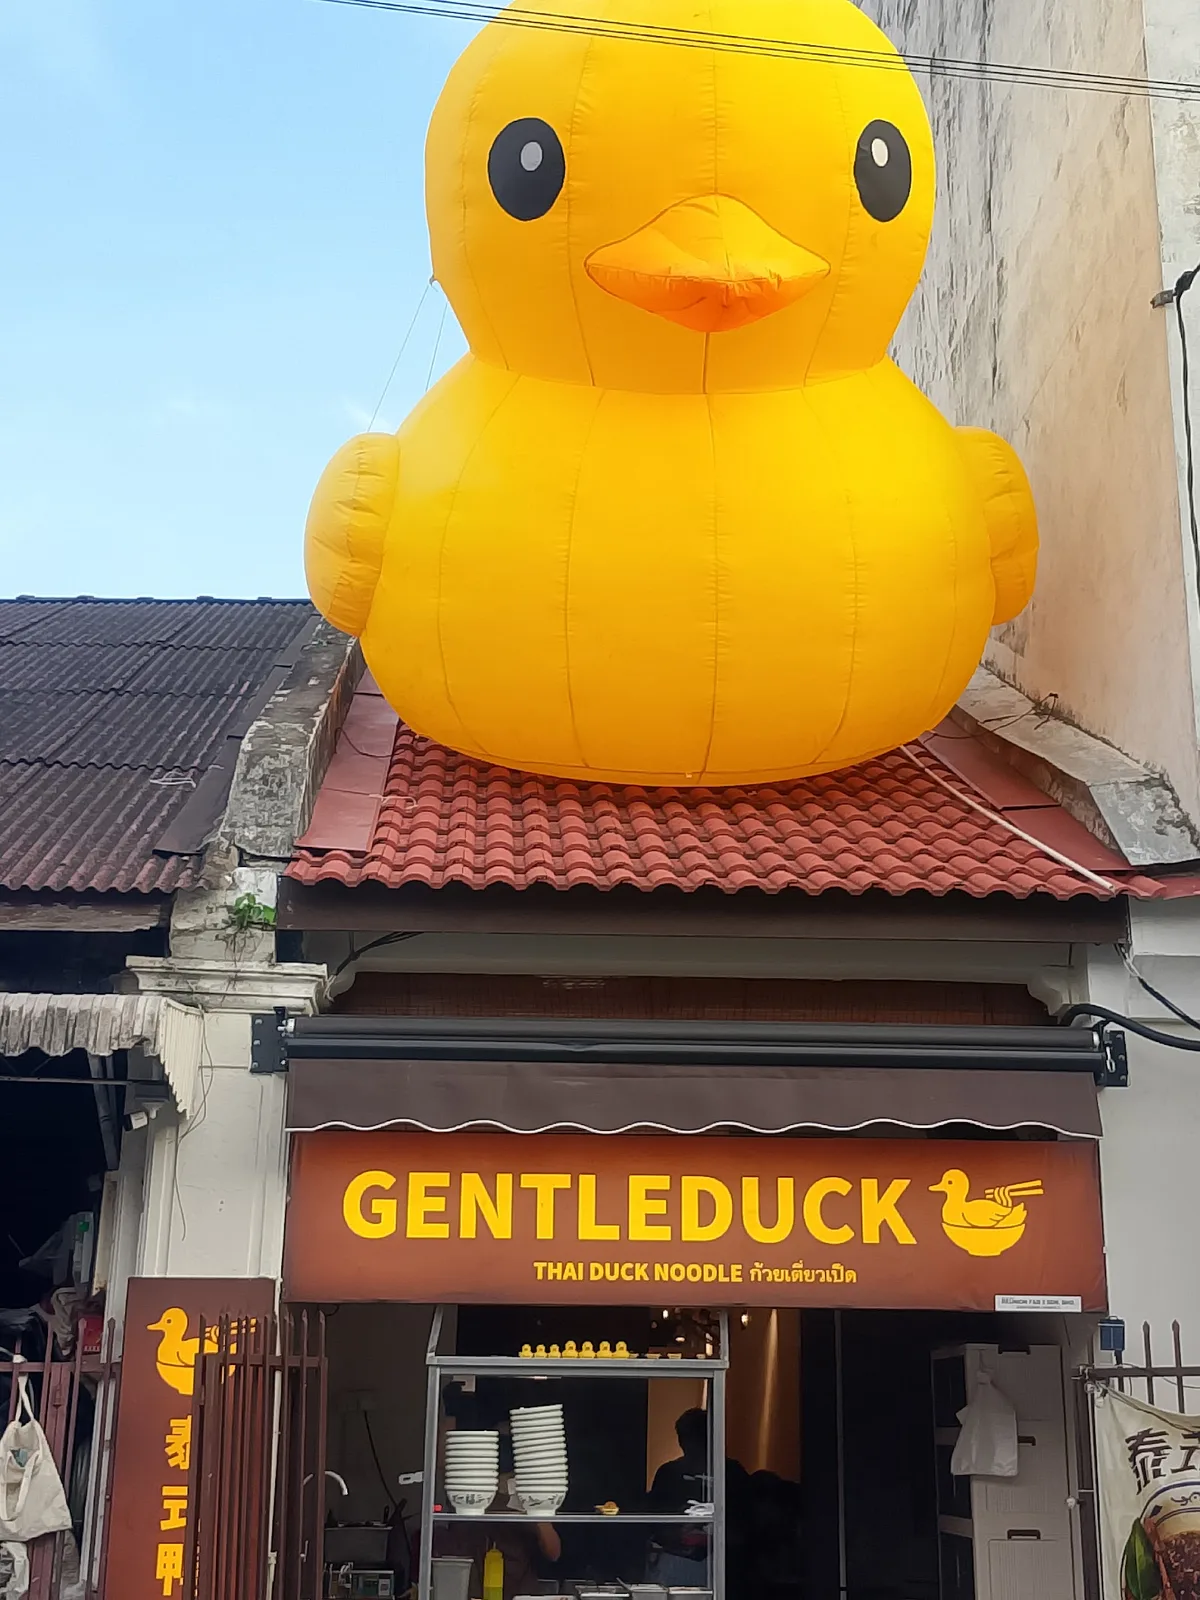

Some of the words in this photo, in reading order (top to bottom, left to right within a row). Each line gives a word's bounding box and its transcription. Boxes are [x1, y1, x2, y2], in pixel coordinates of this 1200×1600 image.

[342, 1169, 919, 1246] GENTLEDUCK
[533, 1260, 585, 1282] THAI
[588, 1261, 650, 1283] DUCK
[653, 1262, 744, 1284] NOODLE
